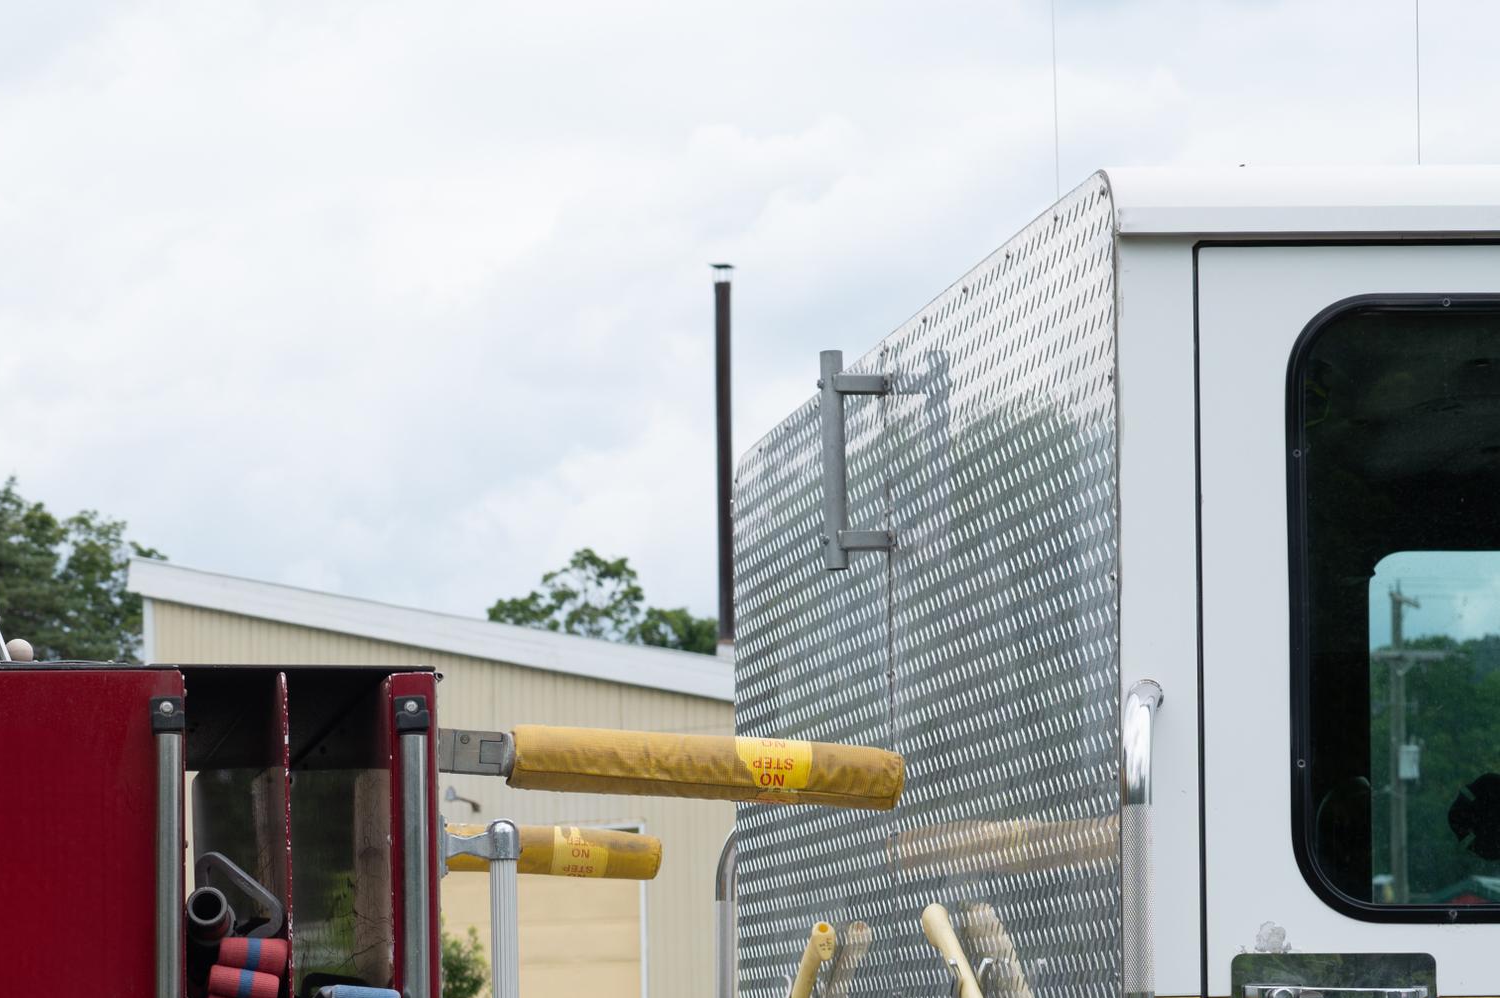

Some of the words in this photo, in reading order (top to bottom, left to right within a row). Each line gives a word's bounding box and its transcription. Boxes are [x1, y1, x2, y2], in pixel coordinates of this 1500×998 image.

[752, 757, 794, 770] STEP
[760, 772, 785, 787] NO
[571, 848, 590, 858] NO
